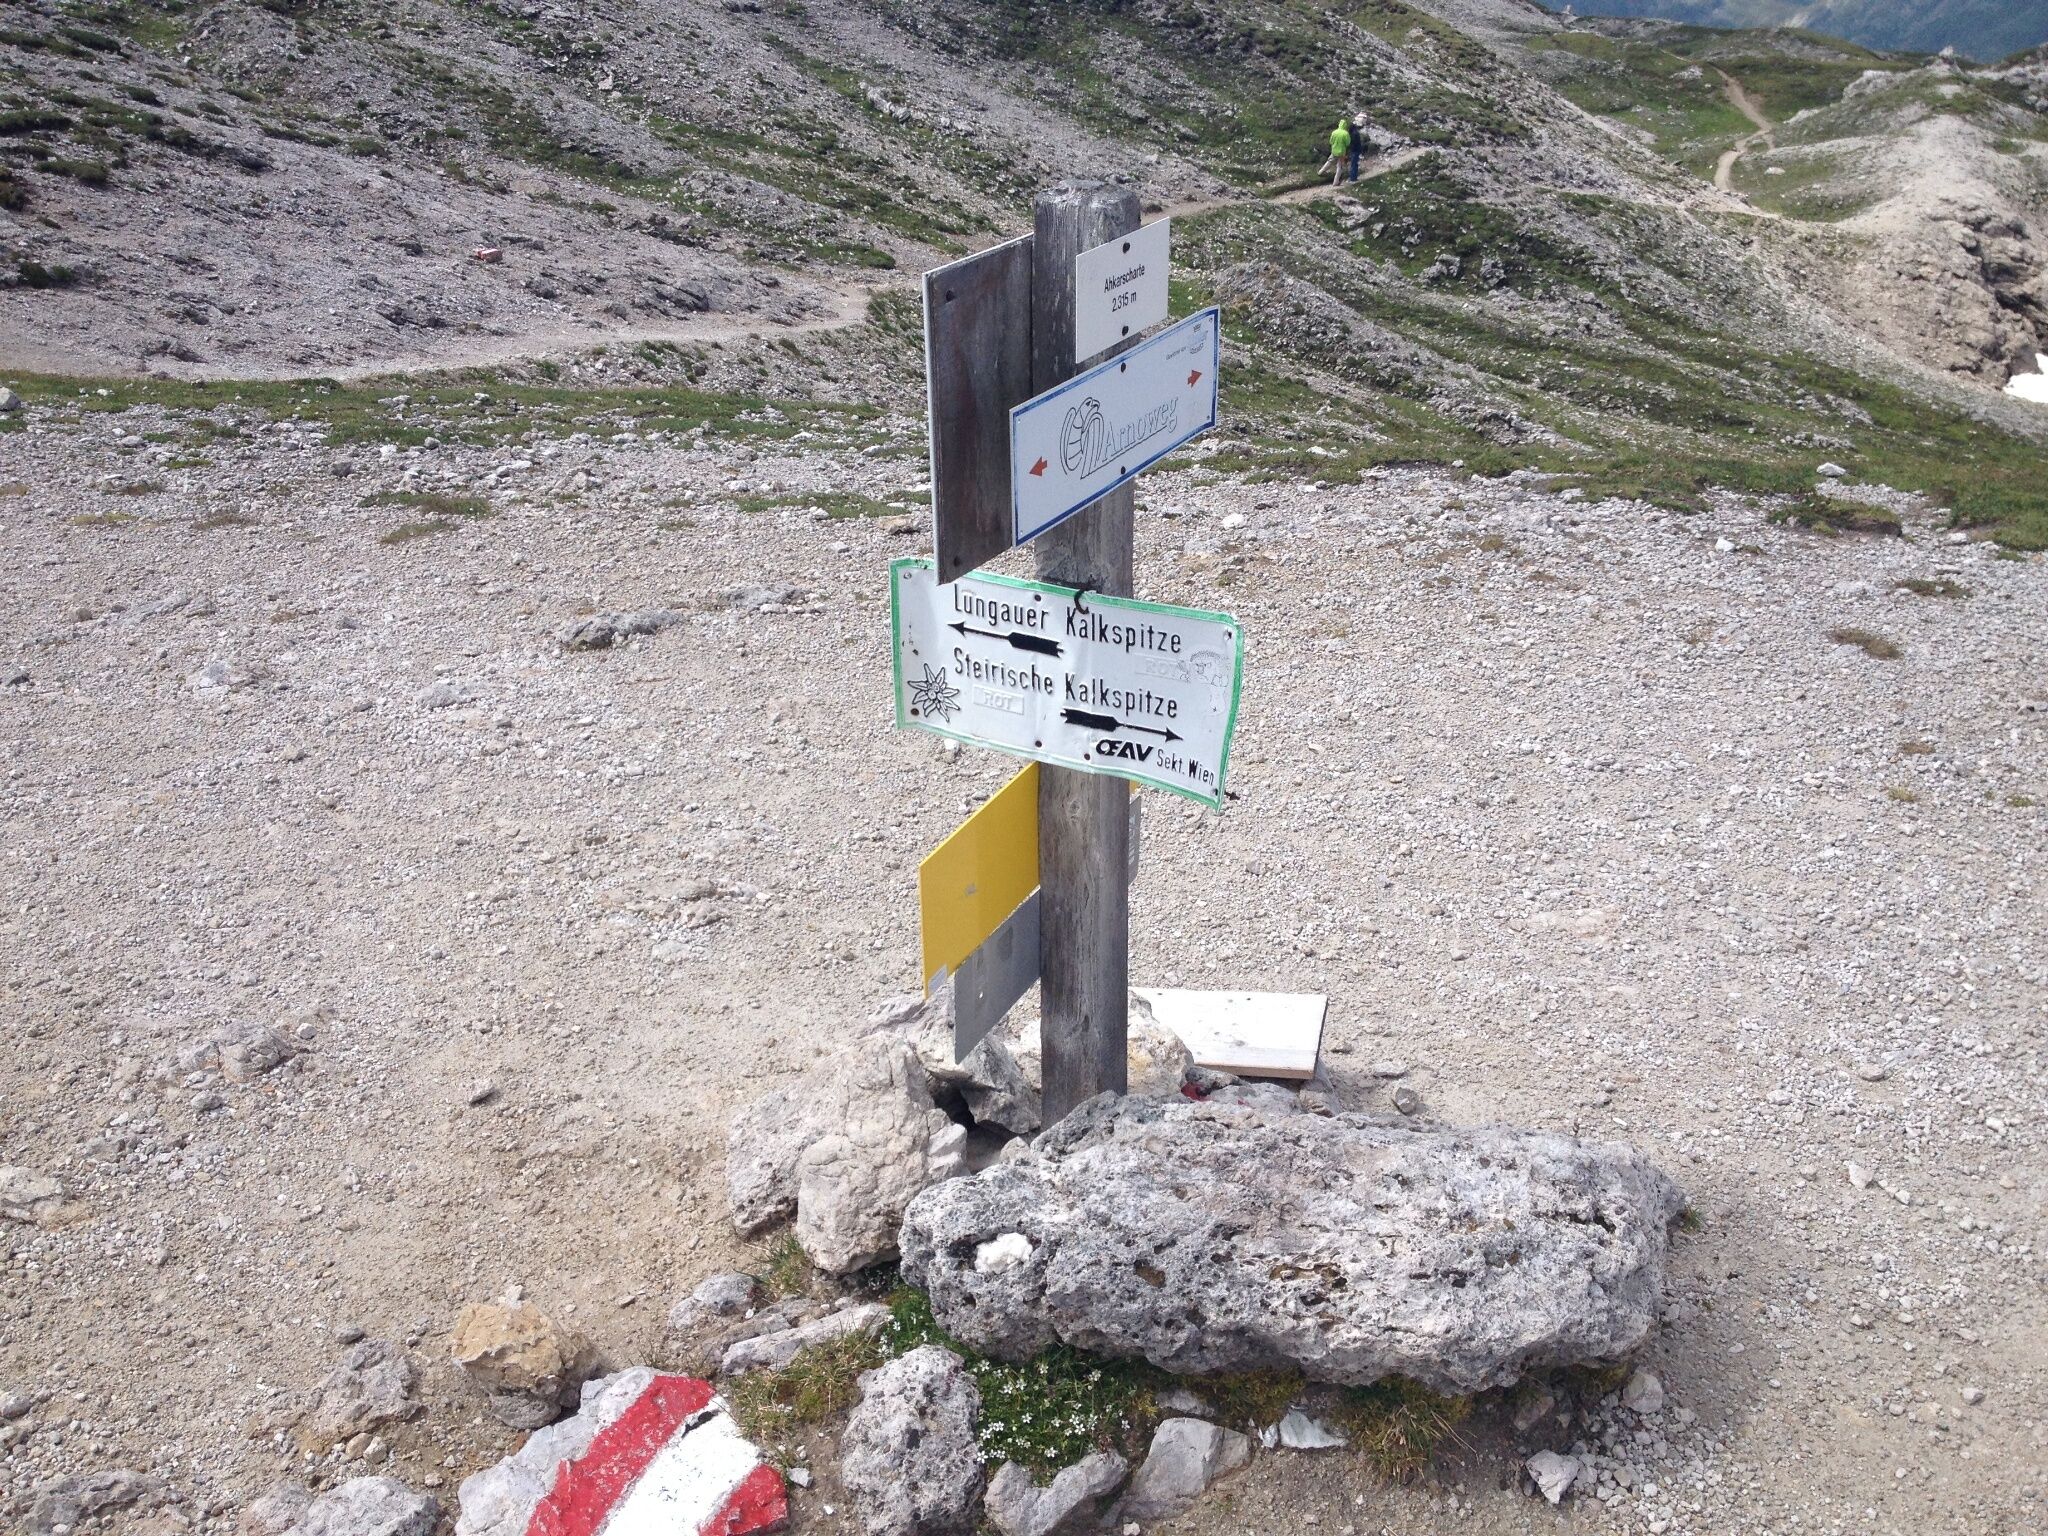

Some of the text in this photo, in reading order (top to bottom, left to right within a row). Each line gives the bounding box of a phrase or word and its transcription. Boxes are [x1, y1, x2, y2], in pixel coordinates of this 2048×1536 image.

[1131, 291, 1137, 302] m
[1101, 396, 1179, 463] Arnoweg
[954, 583, 1181, 654] Lungauer Kalkspitze
[954, 647, 1177, 719] Steirische Kalkspitze
[984, 690, 1012, 710] ROT
[1156, 749, 1185, 776] Sekt.
[1188, 758, 1215, 786] Wien
